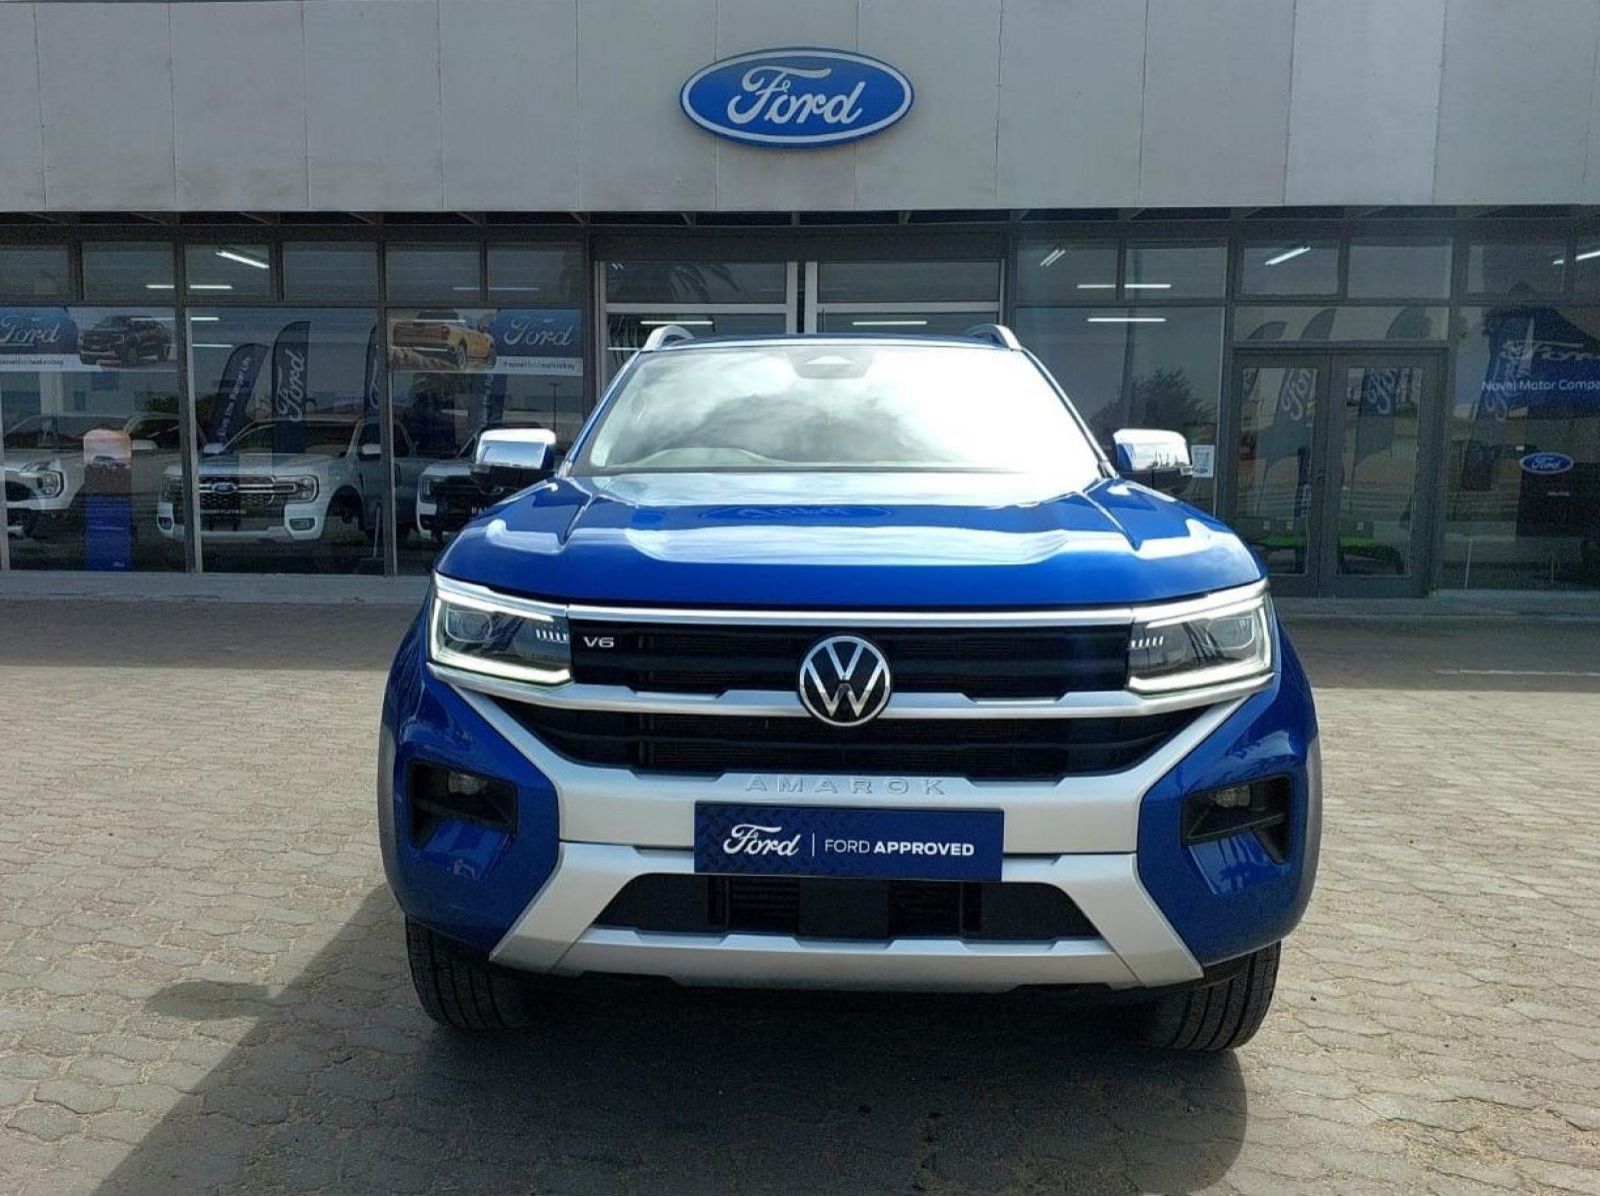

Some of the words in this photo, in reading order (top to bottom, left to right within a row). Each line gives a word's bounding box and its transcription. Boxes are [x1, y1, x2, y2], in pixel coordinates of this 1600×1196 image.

[727, 65, 866, 125] Ford
[0, 315, 61, 343] Ford
[504, 315, 574, 346] Ford
[276, 348, 306, 422] Ford
[1519, 380, 1555, 392] Motor
[1531, 456, 1561, 470] Ford
[583, 635, 615, 649] V6
[745, 774, 945, 796] AMAROK
[723, 823, 801, 857] Ford
[824, 838, 870, 854] FORD
[873, 840, 975, 857] APPROVED
